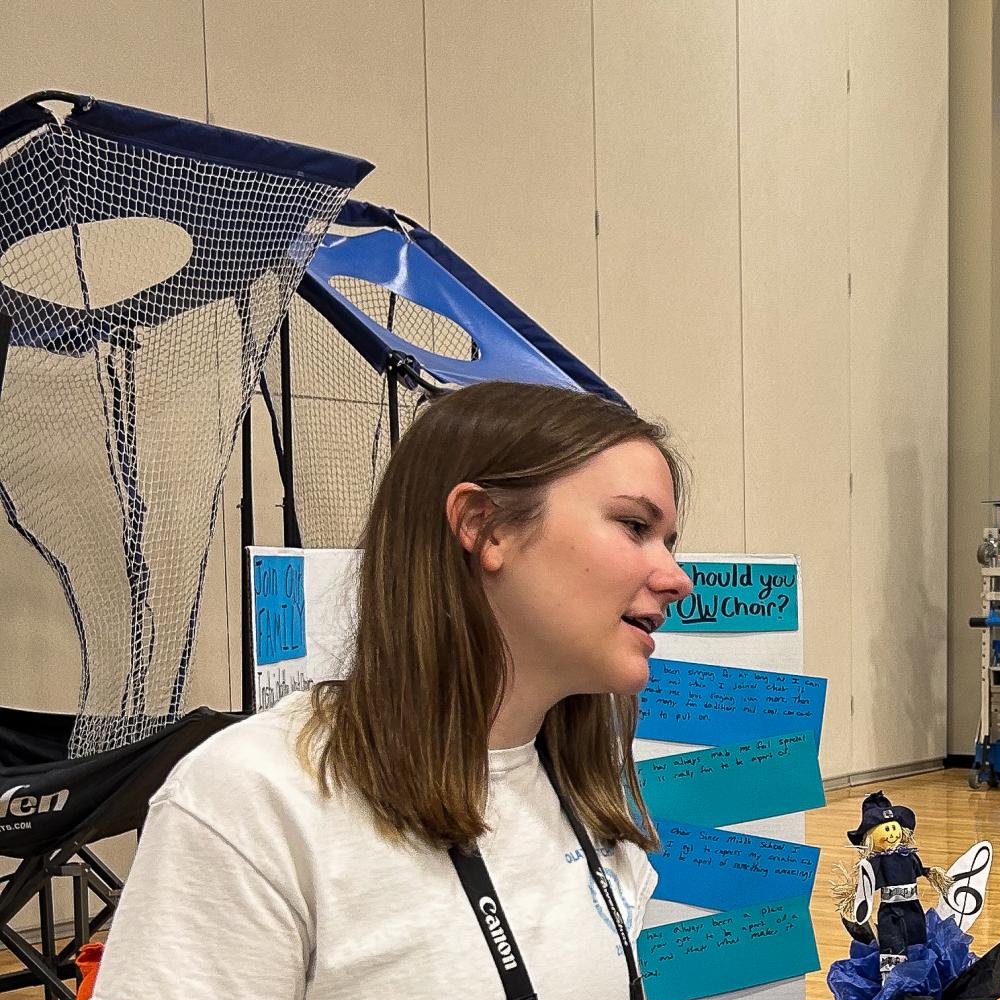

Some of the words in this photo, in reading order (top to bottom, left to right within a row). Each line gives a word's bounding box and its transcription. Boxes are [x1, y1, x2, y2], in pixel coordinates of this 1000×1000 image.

[679, 563, 753, 588] hould
[758, 573, 796, 600] you
[479, 896, 517, 971] Canon
